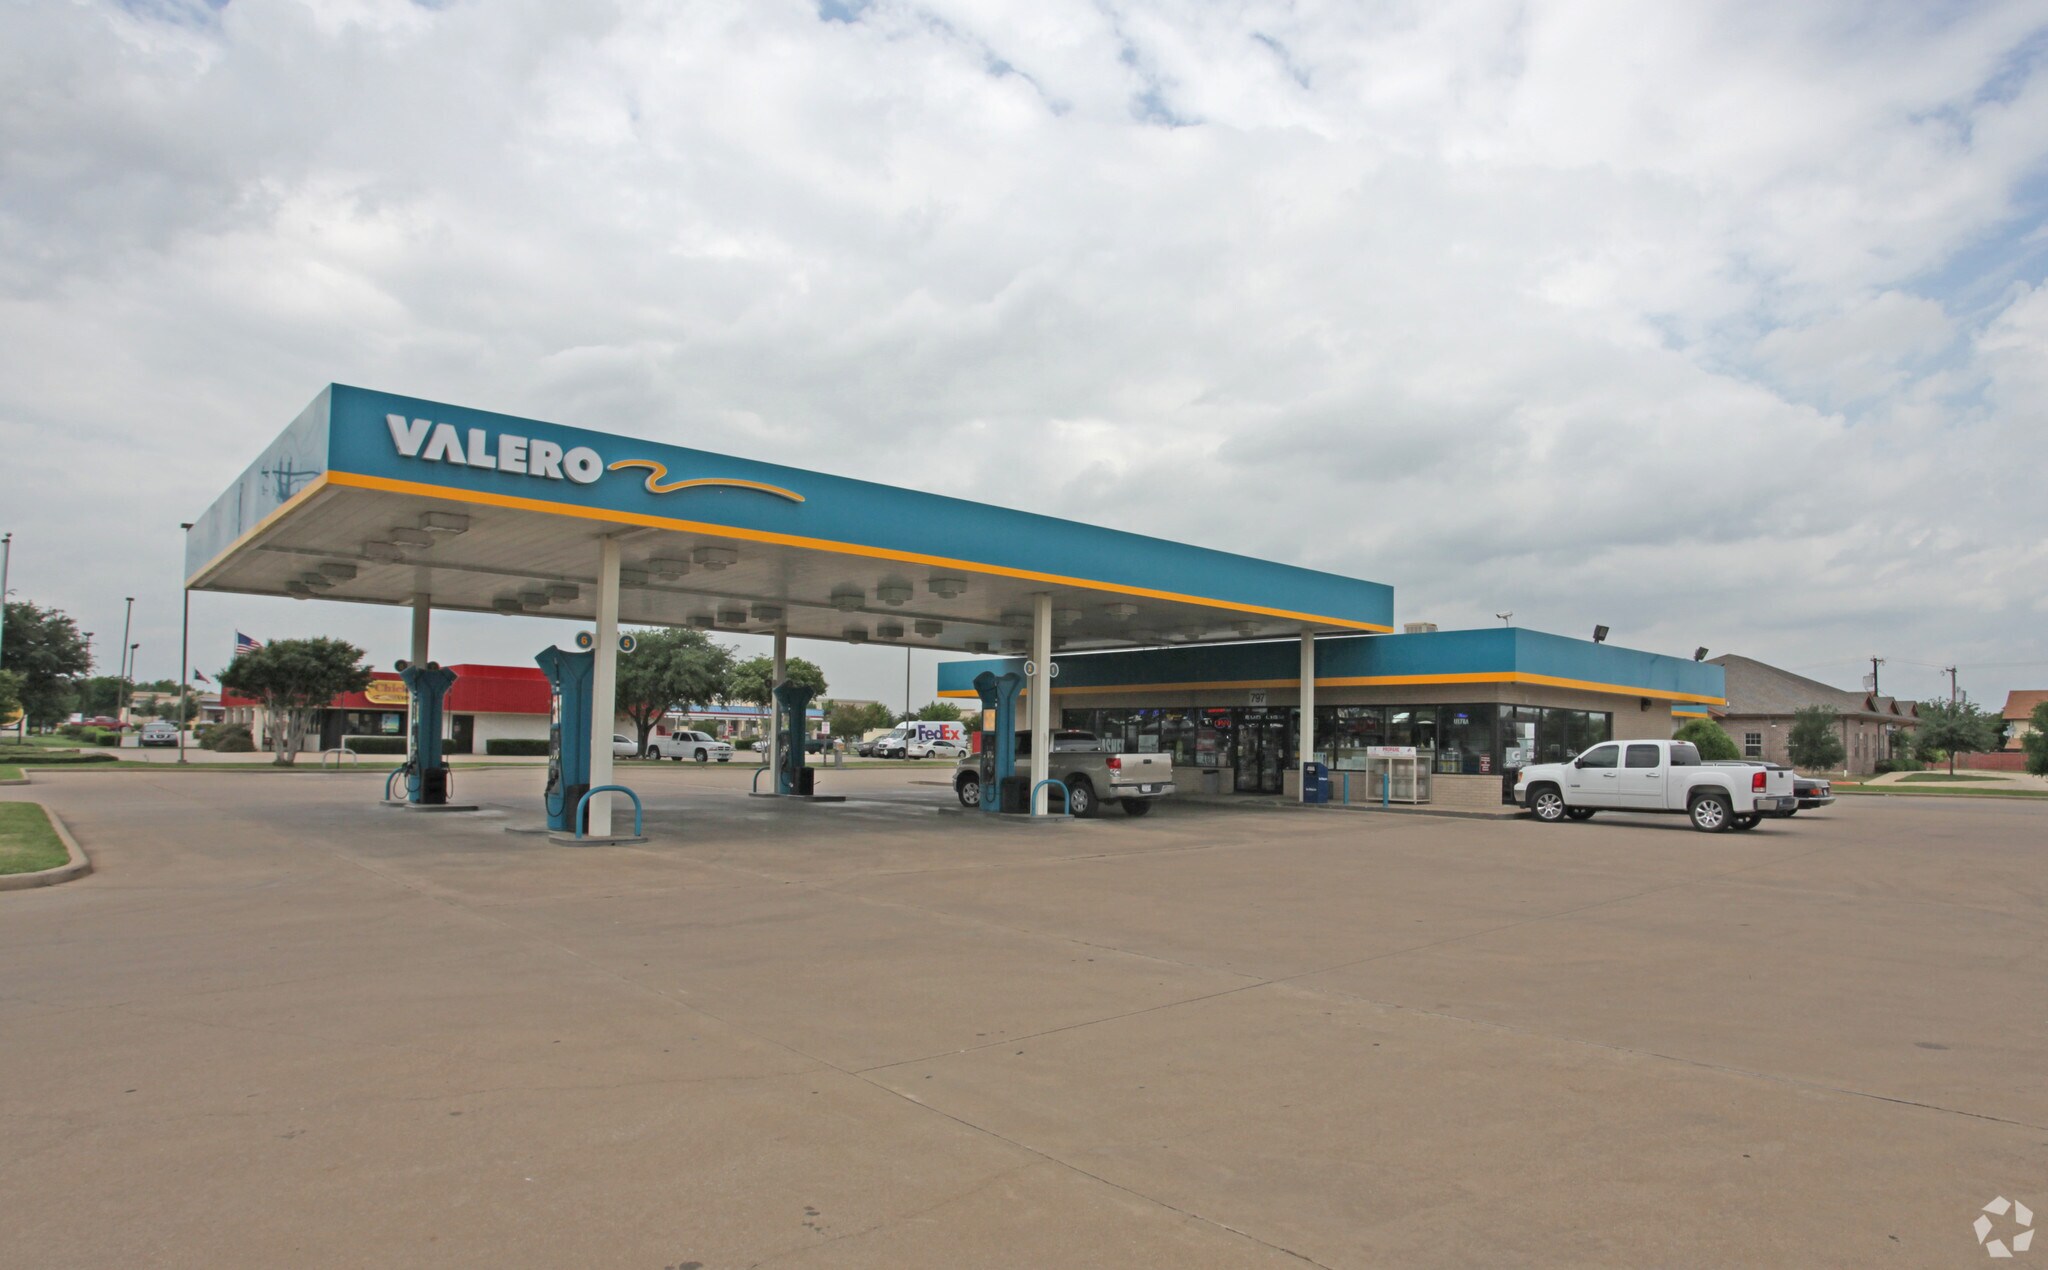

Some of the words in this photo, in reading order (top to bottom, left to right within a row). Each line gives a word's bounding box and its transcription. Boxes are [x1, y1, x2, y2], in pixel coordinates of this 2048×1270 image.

[386, 413, 604, 485] VALERO
[581, 636, 588, 645] 6
[624, 639, 630, 648] 5
[1250, 692, 1265, 703] 797
[918, 724, 960, 741] FedEx
